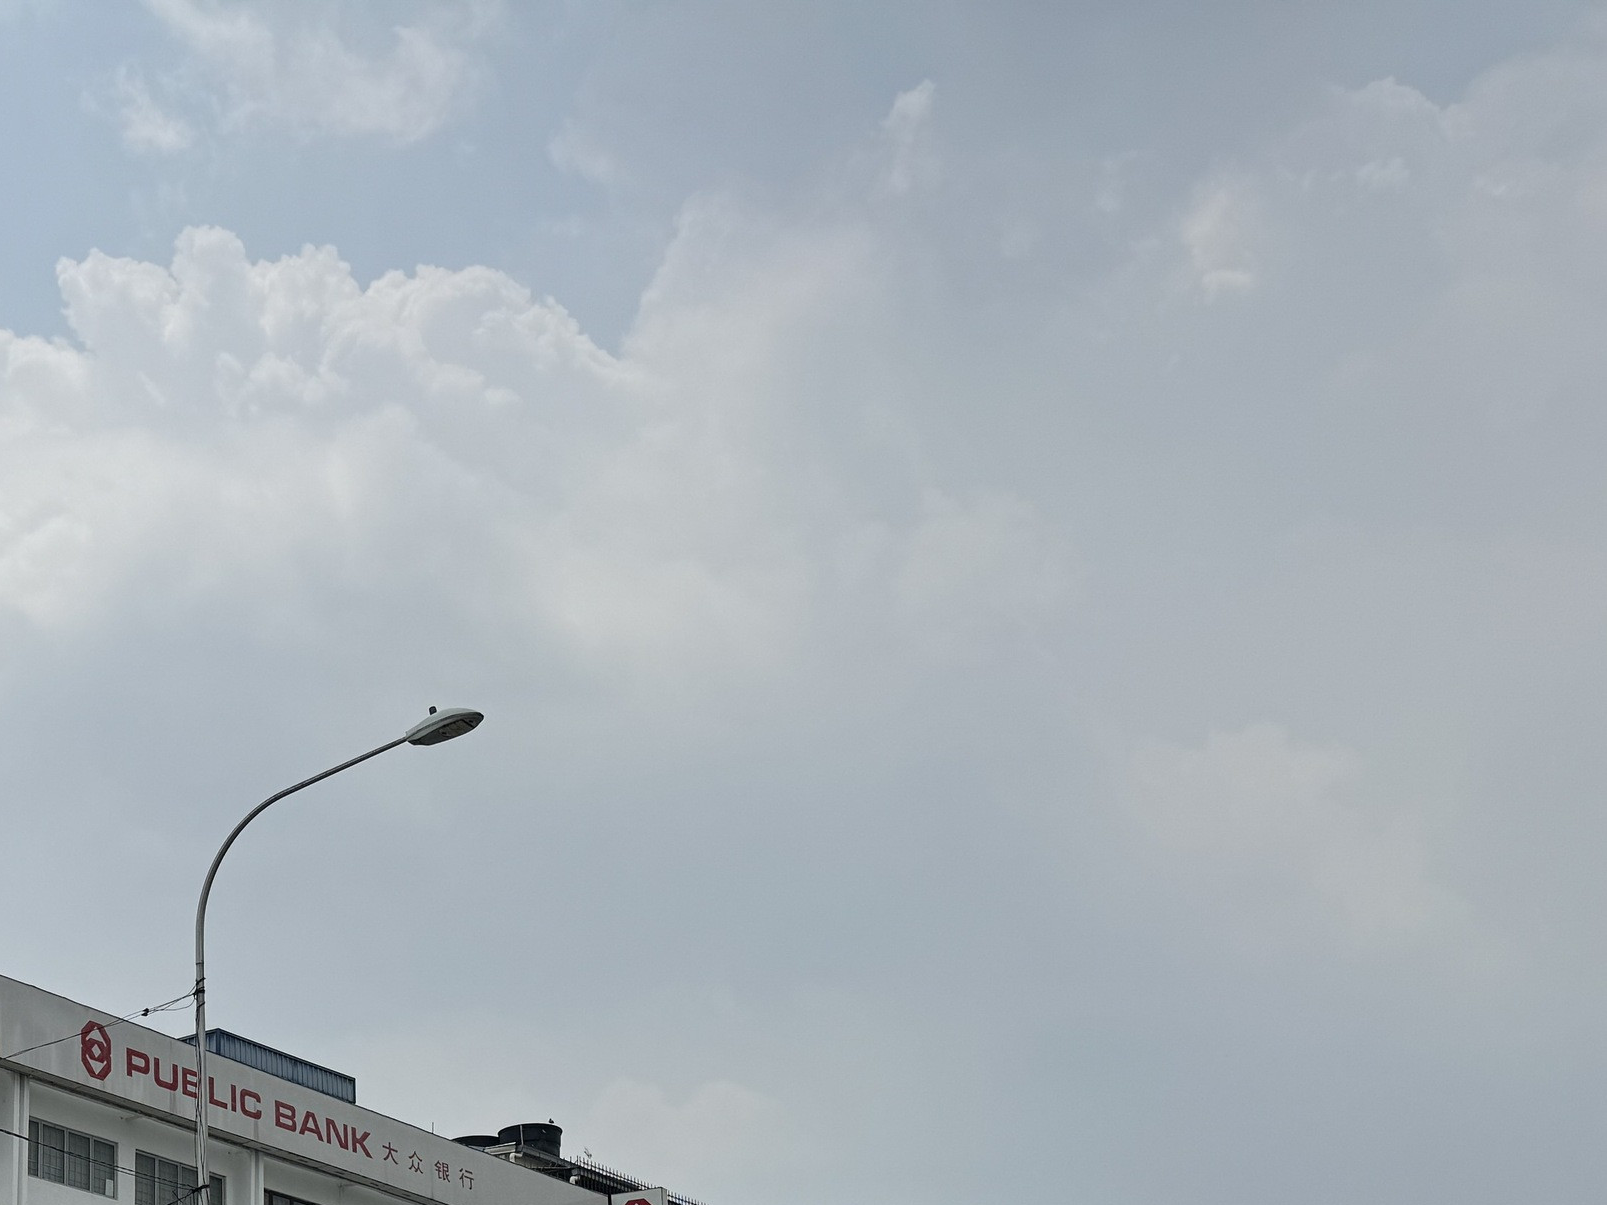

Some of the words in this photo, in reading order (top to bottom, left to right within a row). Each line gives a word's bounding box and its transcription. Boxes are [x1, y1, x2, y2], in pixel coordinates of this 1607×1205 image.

[126, 1047, 262, 1120] PUBLIC
[274, 1099, 373, 1159] BANK
[382, 1142, 475, 1191] 大众银行
